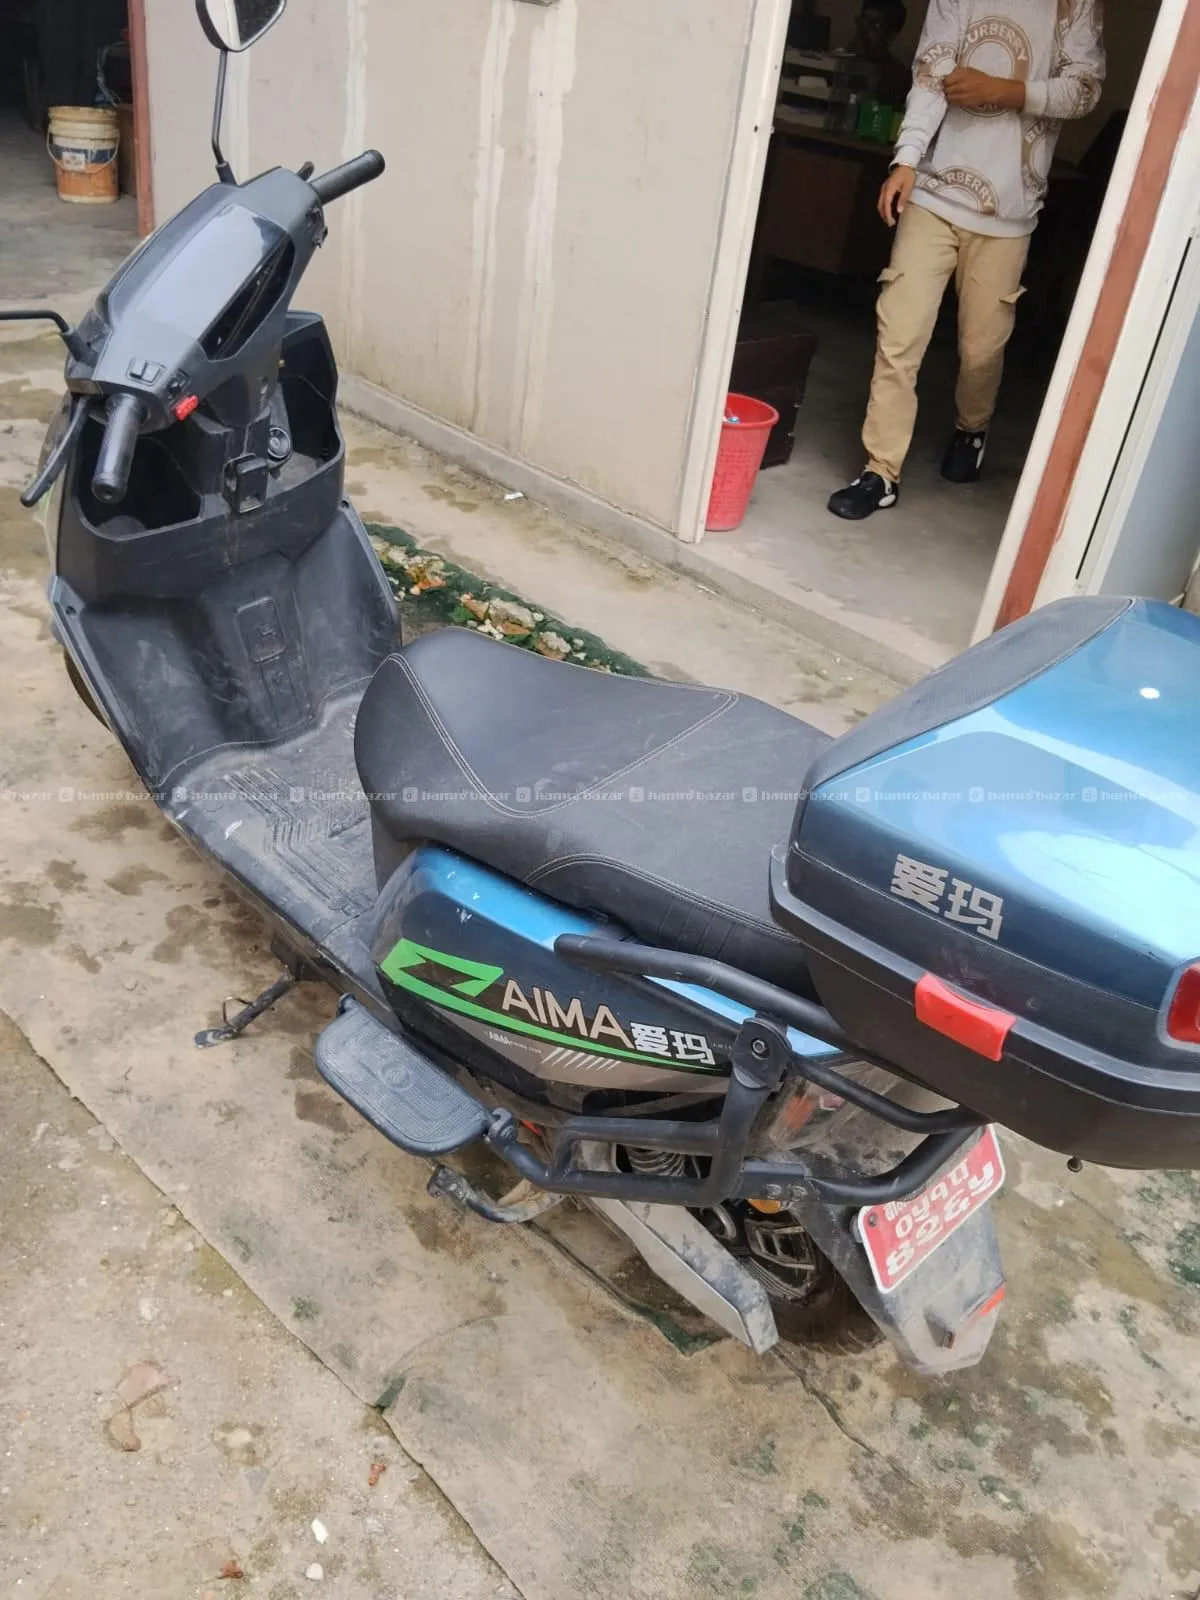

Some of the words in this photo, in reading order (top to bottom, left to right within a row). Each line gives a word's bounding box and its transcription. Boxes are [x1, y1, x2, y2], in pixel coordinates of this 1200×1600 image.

[890, 853, 1004, 941] 爱玛
[502, 978, 635, 1049] AIMA
[631, 1022, 715, 1065] 爱玛
